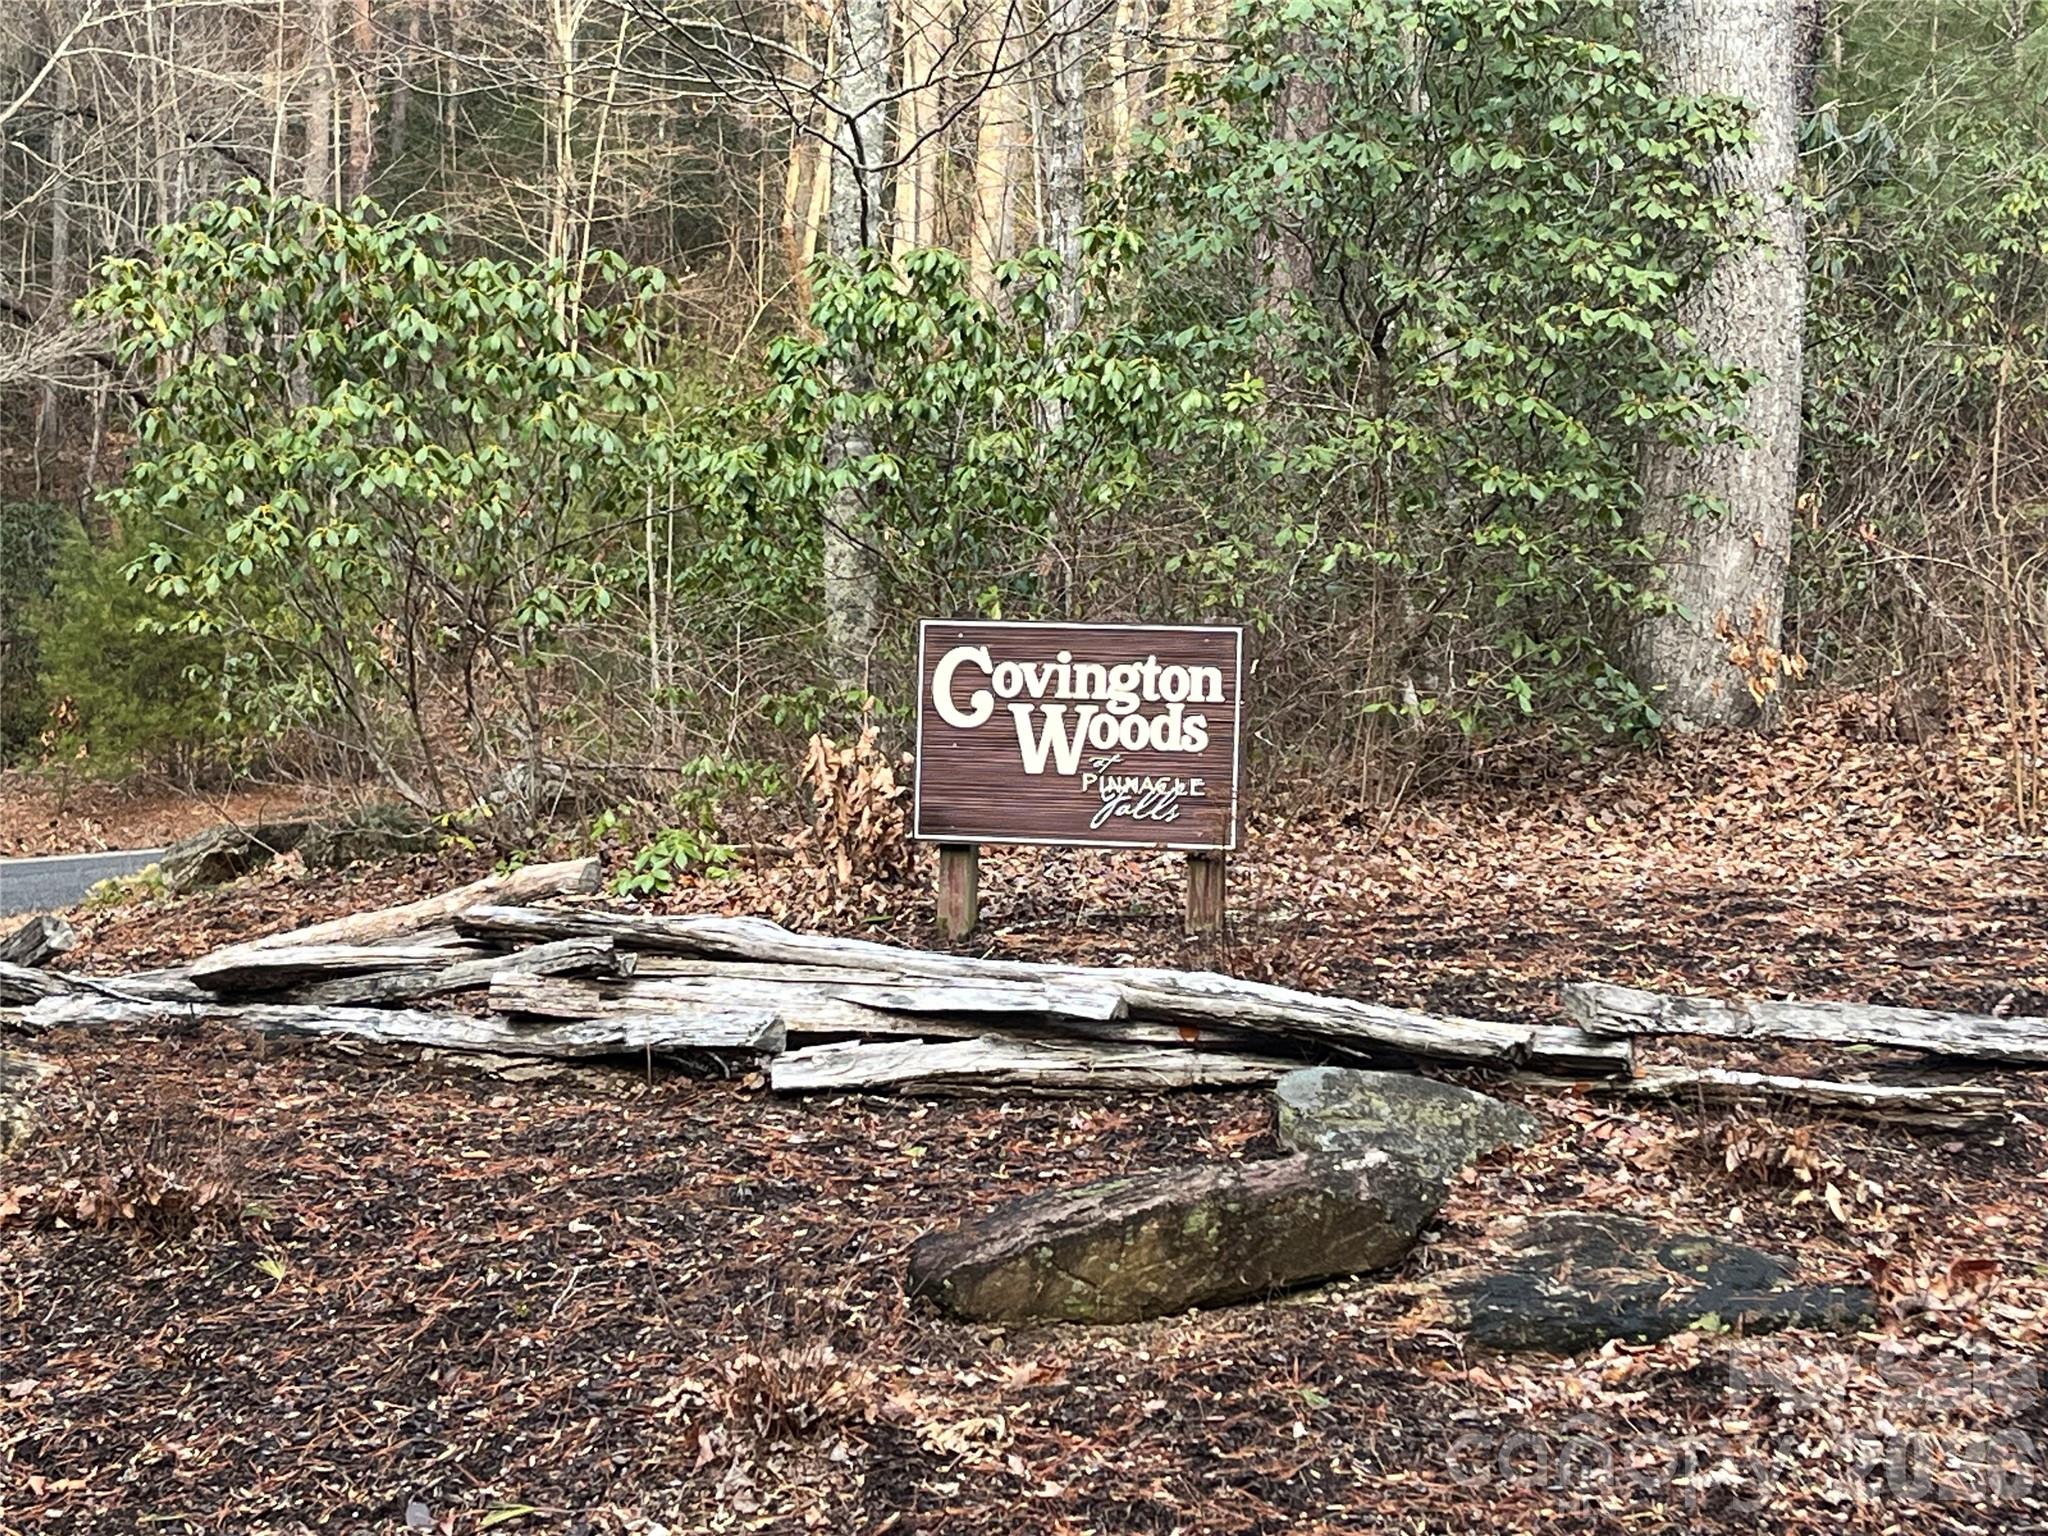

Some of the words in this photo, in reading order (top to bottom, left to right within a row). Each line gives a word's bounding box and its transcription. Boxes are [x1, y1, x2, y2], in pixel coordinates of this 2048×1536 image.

[932, 646, 1225, 728] Covington
[1007, 702, 1209, 775] Woods
[1089, 753, 1122, 773] at
